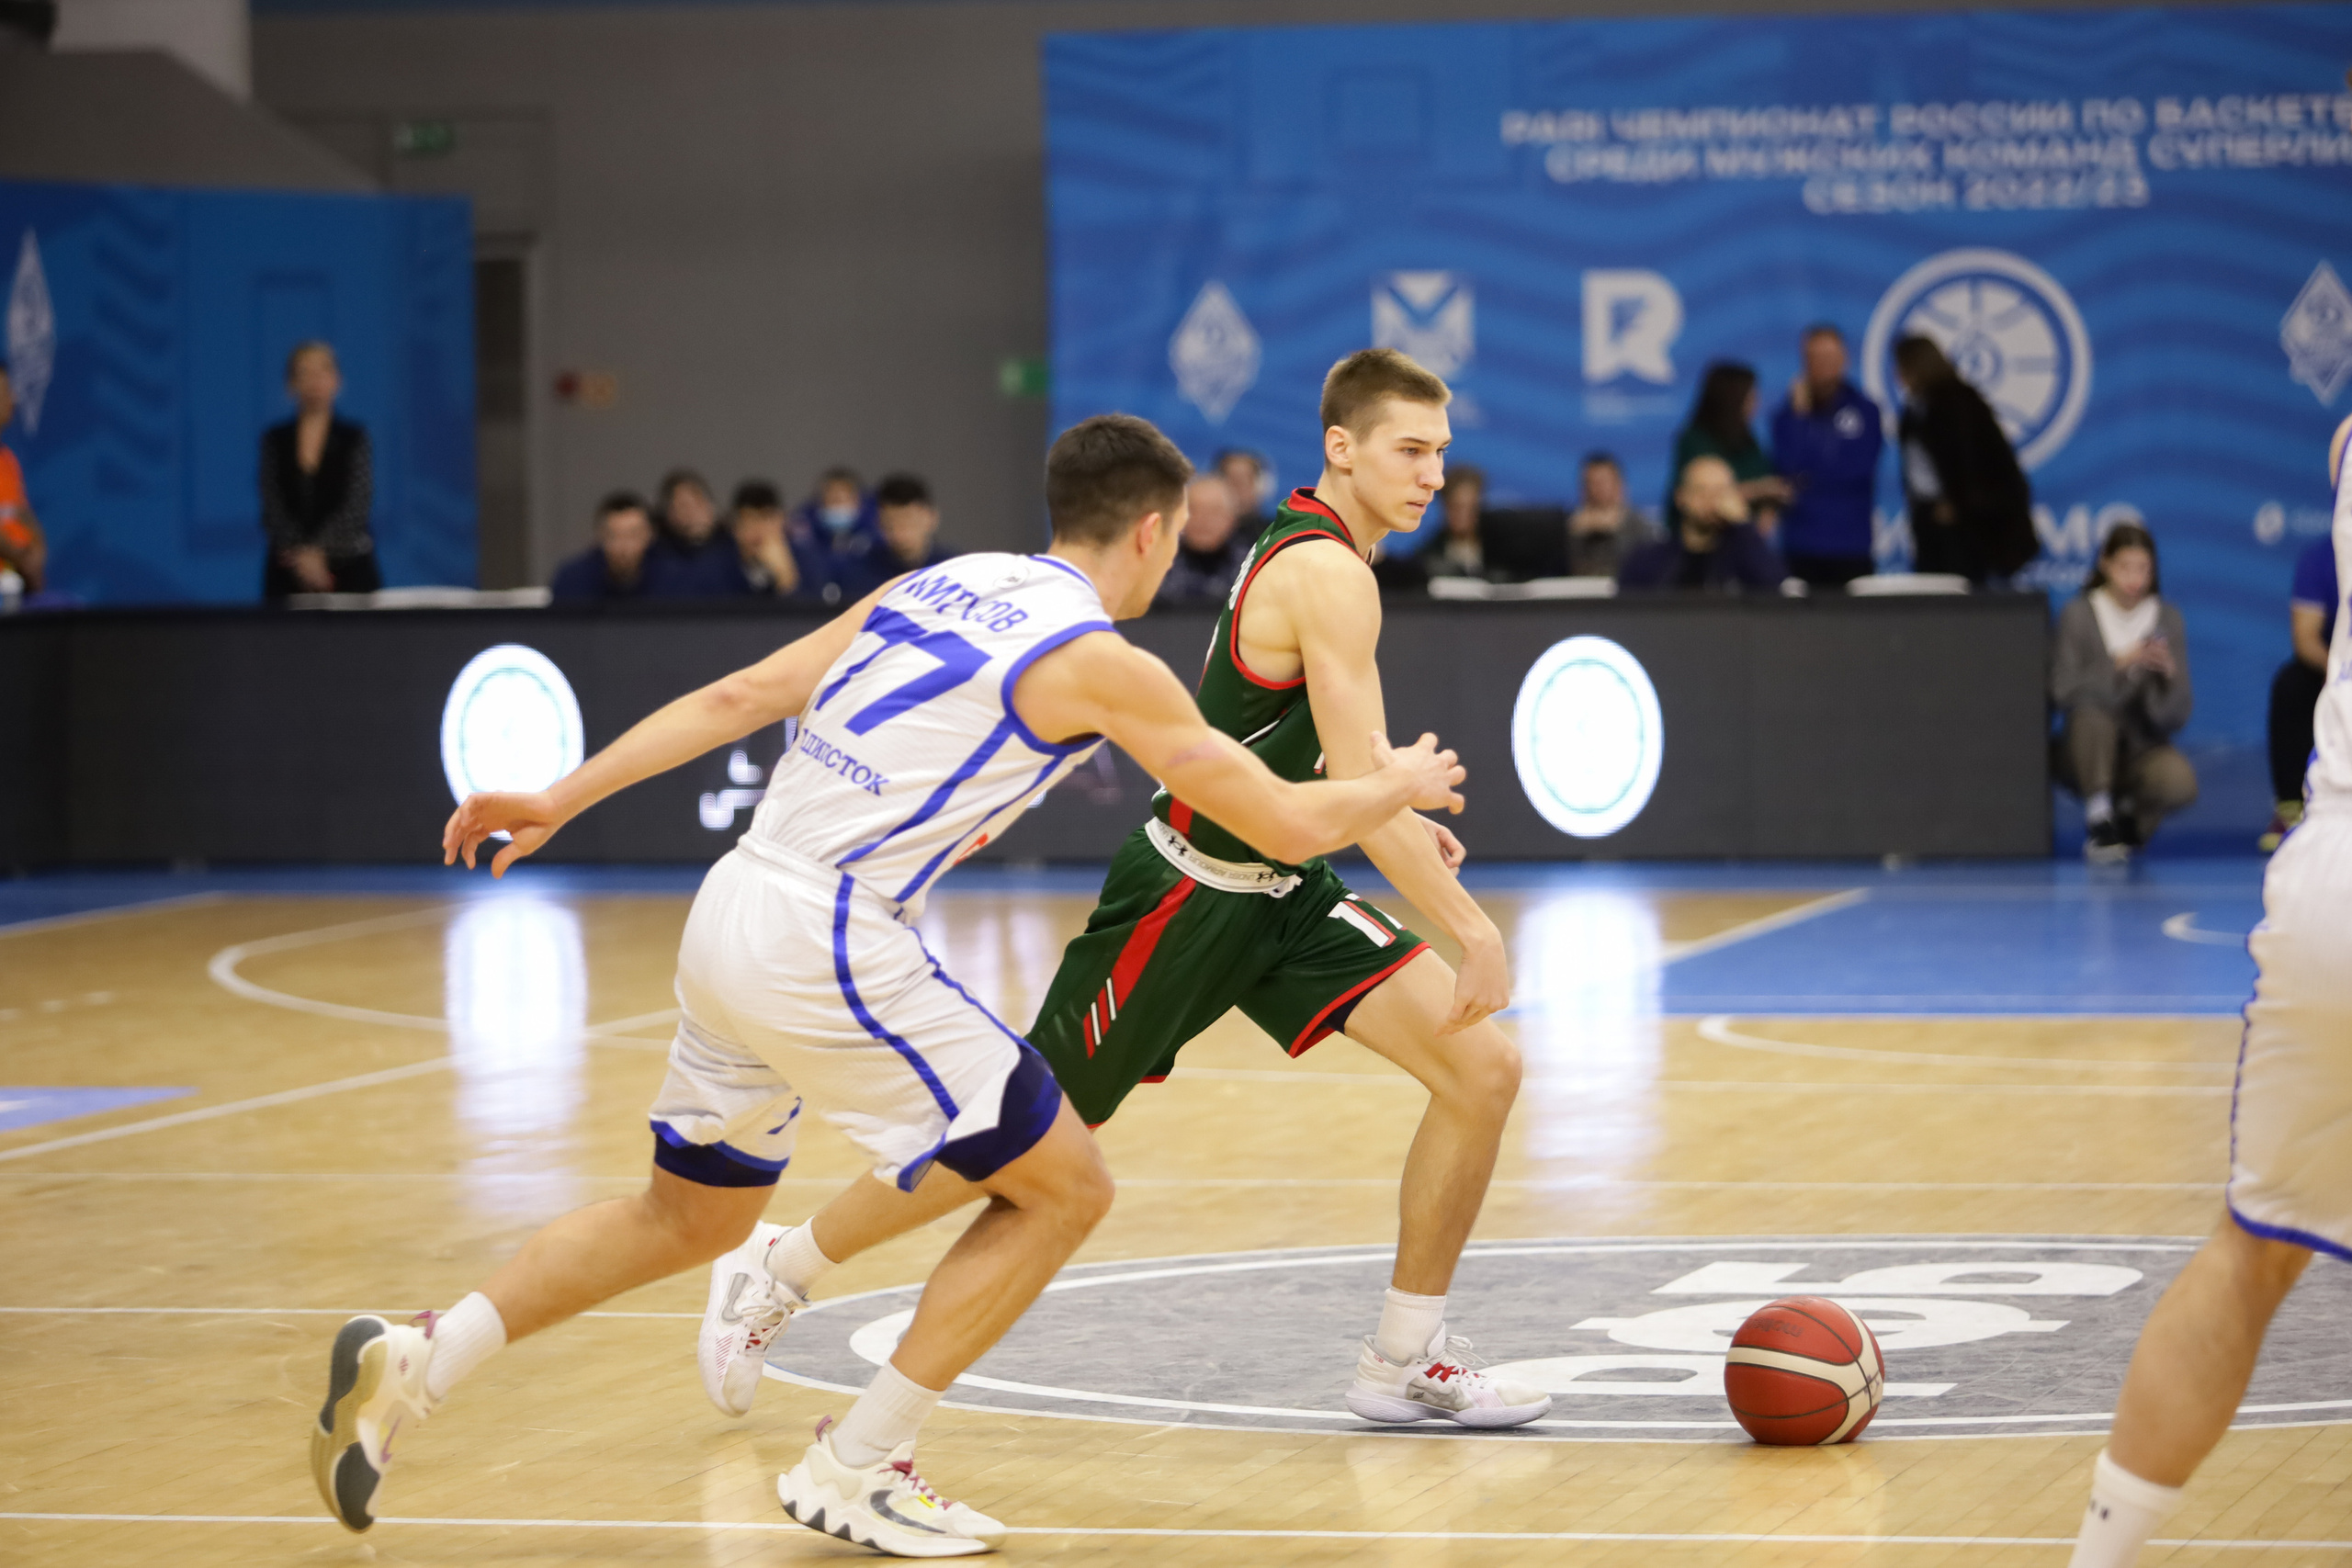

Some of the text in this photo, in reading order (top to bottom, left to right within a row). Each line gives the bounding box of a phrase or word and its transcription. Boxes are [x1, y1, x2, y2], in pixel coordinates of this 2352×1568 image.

[1611, 105, 1878, 141] ЧЕМПИОНАТ
[1891, 100, 2074, 141] РОССИИ
[2082, 96, 2145, 136] ПО
[1545, 144, 1698, 184] СРЕДИ
[1704, 138, 1931, 178] МУЖСКИХ
[1943, 135, 2138, 174] КОМАНД
[1804, 174, 2149, 215] СЕЗОН 2022/23
[814, 604, 994, 737] 77
